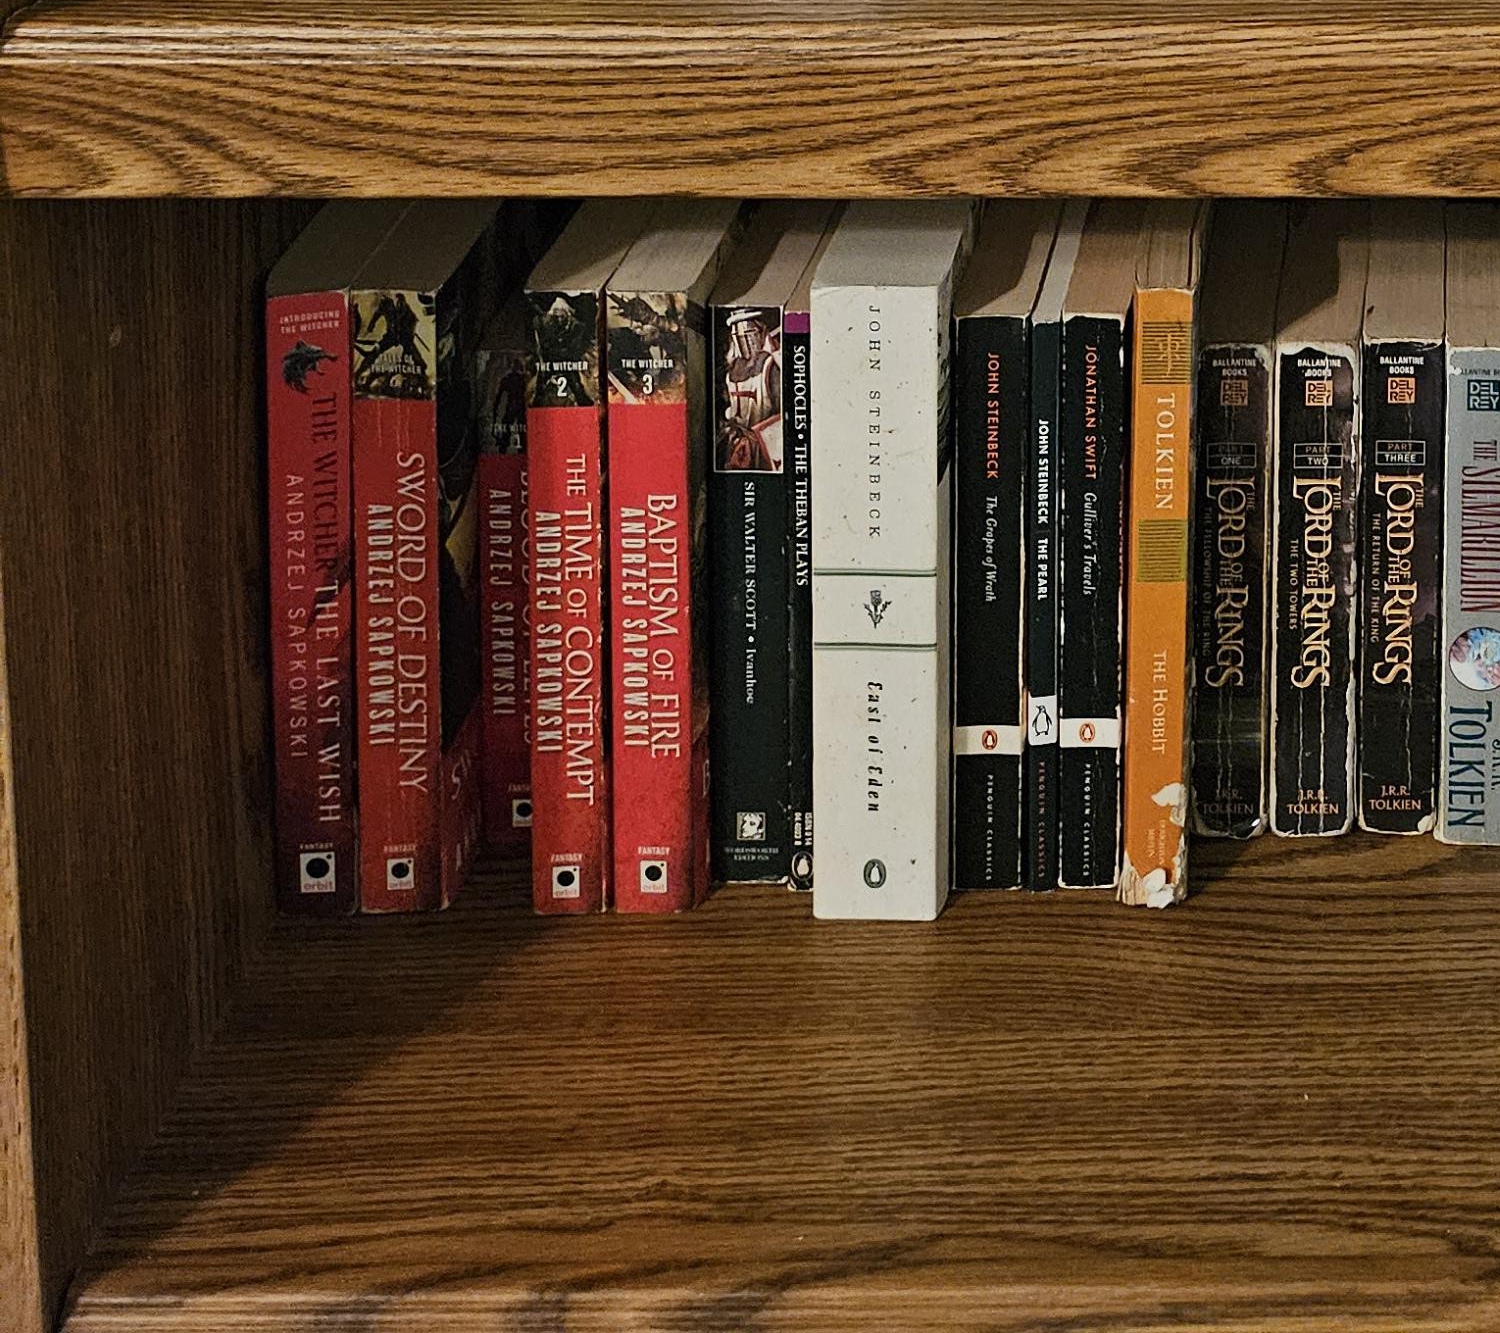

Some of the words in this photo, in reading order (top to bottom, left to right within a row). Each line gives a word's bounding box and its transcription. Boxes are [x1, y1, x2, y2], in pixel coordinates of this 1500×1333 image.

[868, 305, 881, 372] JOHN
[1084, 345, 1097, 432] JONATHAN
[868, 390, 881, 538] STEINBECK
[1084, 435, 1098, 479] SWIFT
[1154, 393, 1175, 510] TOLKIEN
[367, 504, 394, 603] ANDRZEJ
[395, 451, 426, 582] SWORD
[647, 494, 680, 636] BAPTISM
[398, 595, 426, 641] OF
[650, 649, 674, 681] OF
[368, 616, 395, 744] SAPKOWSKI
[398, 654, 427, 792] DESTINY
[650, 692, 681, 758] FIRE
[1447, 701, 1491, 827] TOLKIEN
